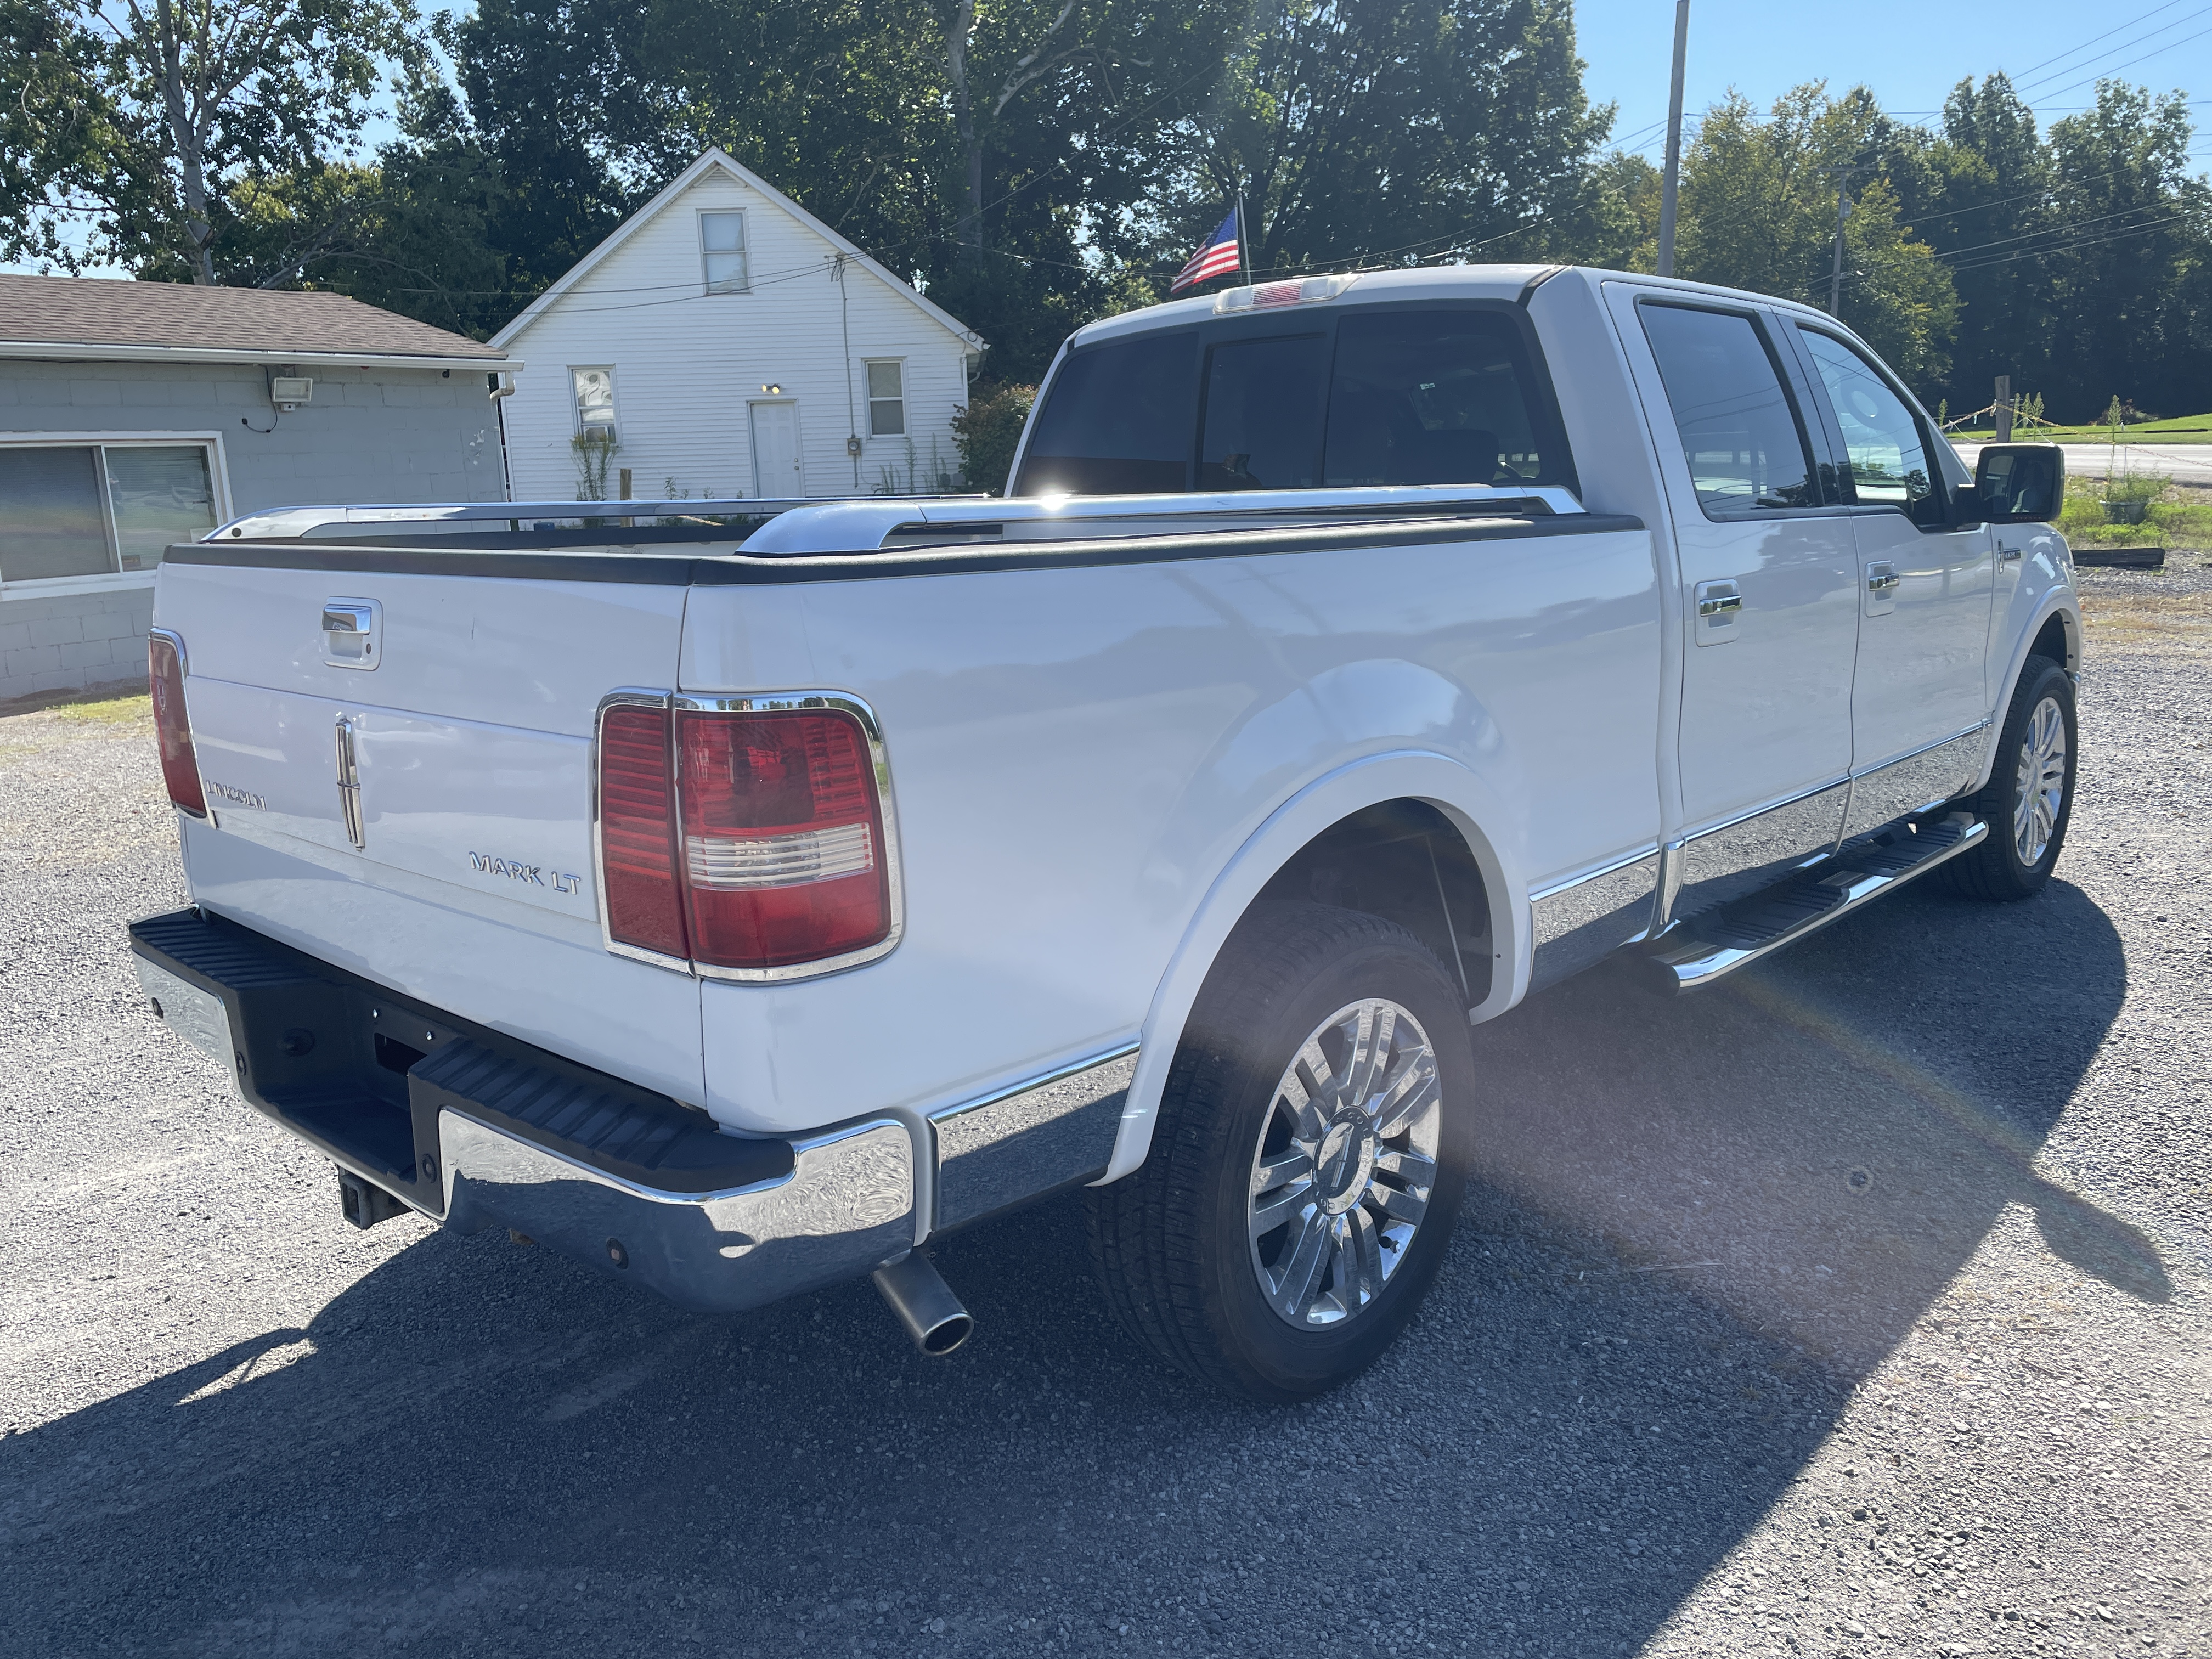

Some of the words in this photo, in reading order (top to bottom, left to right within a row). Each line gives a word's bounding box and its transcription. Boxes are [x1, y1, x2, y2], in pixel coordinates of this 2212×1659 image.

[206, 780, 268, 811] LINCOLN
[469, 851, 545, 887] MARK
[551, 871, 582, 895] LT
